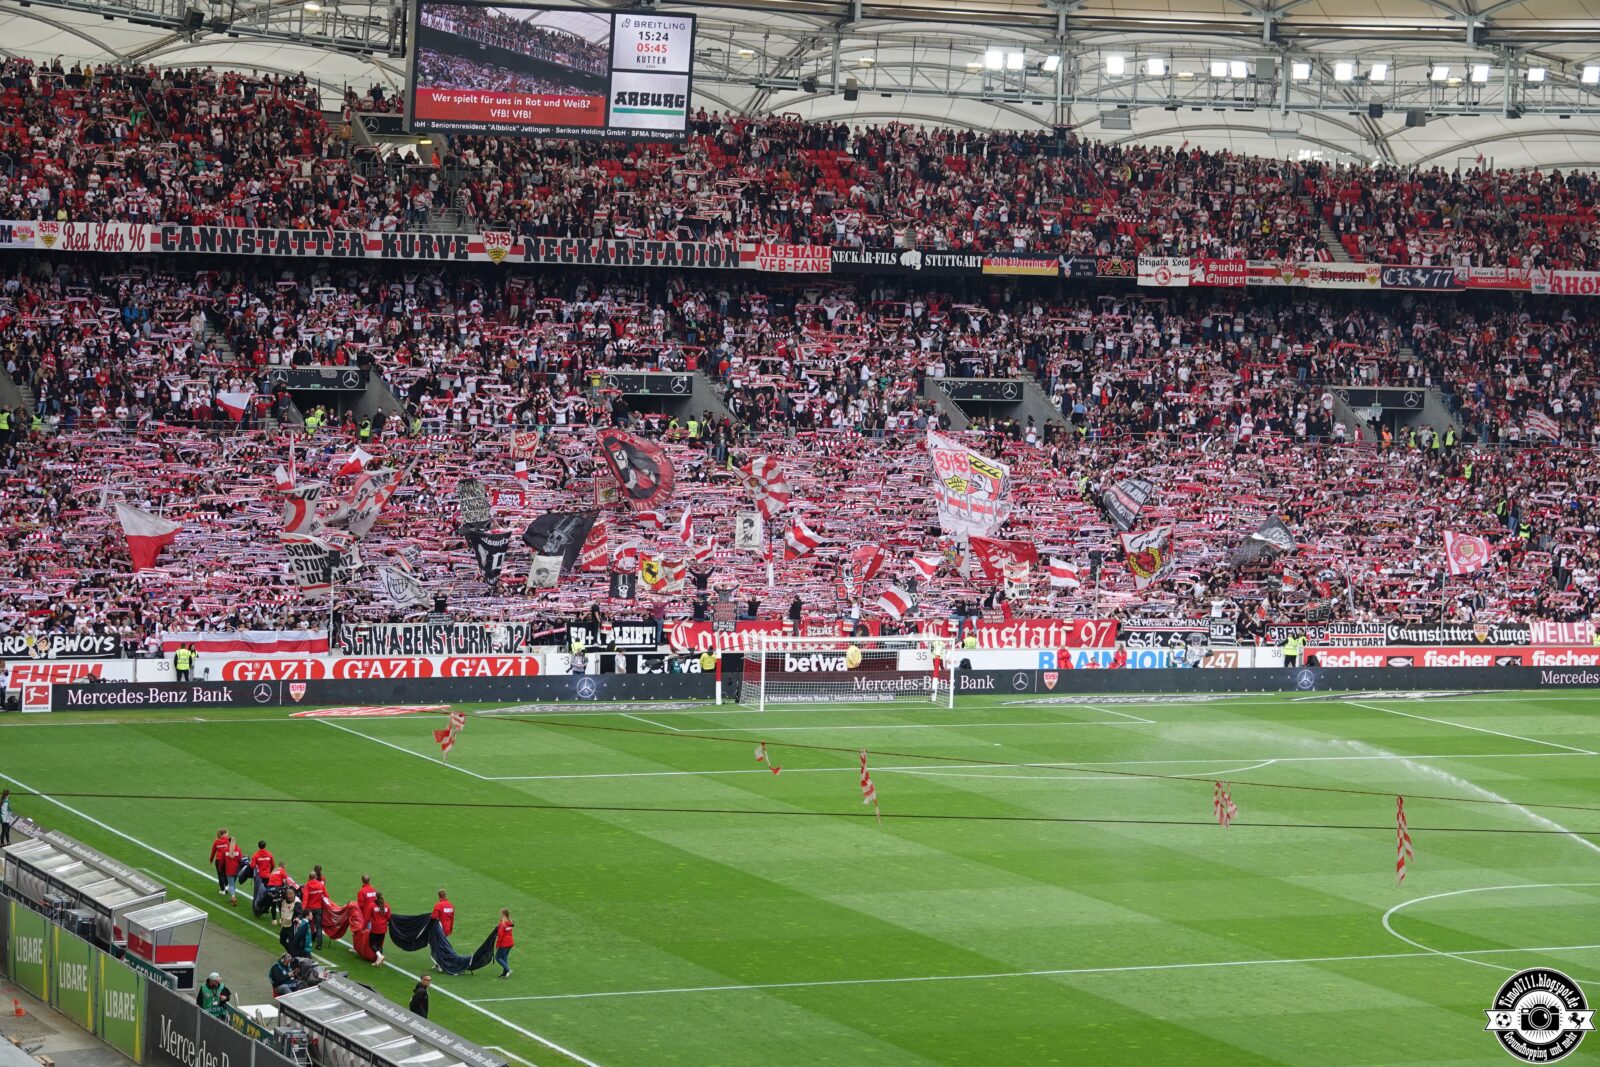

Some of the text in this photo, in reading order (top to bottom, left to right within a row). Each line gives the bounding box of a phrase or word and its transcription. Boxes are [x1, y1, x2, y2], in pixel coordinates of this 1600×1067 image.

[634, 20, 686, 31] BREITLING
[638, 31, 669, 41] 15:24
[636, 43, 667, 53] 05:45
[636, 55, 667, 65] KUTTER
[432, 93, 451, 102] Wer
[453, 94, 478, 104] spielt
[480, 95, 495, 104] für
[514, 97, 522, 106] in
[525, 97, 541, 106] Rot
[543, 99, 560, 107] und
[563, 99, 591, 109] Weiß?
[614, 91, 686, 108] ARBURG
[490, 109, 532, 119] VfB! VfB!
[431, 122, 486, 131] Seniorenresidenz
[488, 124, 520, 132] "Albblick"
[521, 126, 550, 134] Jettingen
[556, 127, 580, 135] Serikon
[581, 128, 606, 136] Holding
[62, 221, 146, 251] Red Hots 96
[381, 231, 469, 260] KURVE
[524, 237, 741, 268] NECKARSTADION
[758, 243, 832, 259] ALBSTADT
[758, 257, 831, 272] VFB-FANS
[832, 250, 983, 268] NECKAR-FILS STUTTGART
[1008, 257, 1047, 269] Warriors
[1208, 261, 1244, 272] Suebia
[1319, 267, 1366, 284] Hessen
[1431, 269, 1454, 287] 77
[1080, 621, 1112, 648] 97
[1387, 623, 1475, 643] Cannstatter
[1530, 622, 1595, 644] WEILER
[52, 635, 115, 654] BWOYS
[1330, 637, 1385, 647] STUTTGART
[915, 651, 927, 661] 35
[1271, 650, 1282, 658] 36
[1315, 650, 1384, 668] fischer
[1423, 650, 1492, 667] fischer
[1532, 650, 1600, 667] fischer
[156, 661, 170, 672] 33
[784, 653, 850, 673] betwa
[8, 663, 103, 689] EHEIM
[852, 675, 995, 691] Mercedes-Bnz Bank
[1540, 670, 1600, 685] Mercedes-
[66, 686, 233, 705] Mercedes-Benz Bank
[15, 935, 44, 965] LIBARE
[59, 960, 88, 992] LIBARE
[104, 988, 136, 1022] LIBARE
